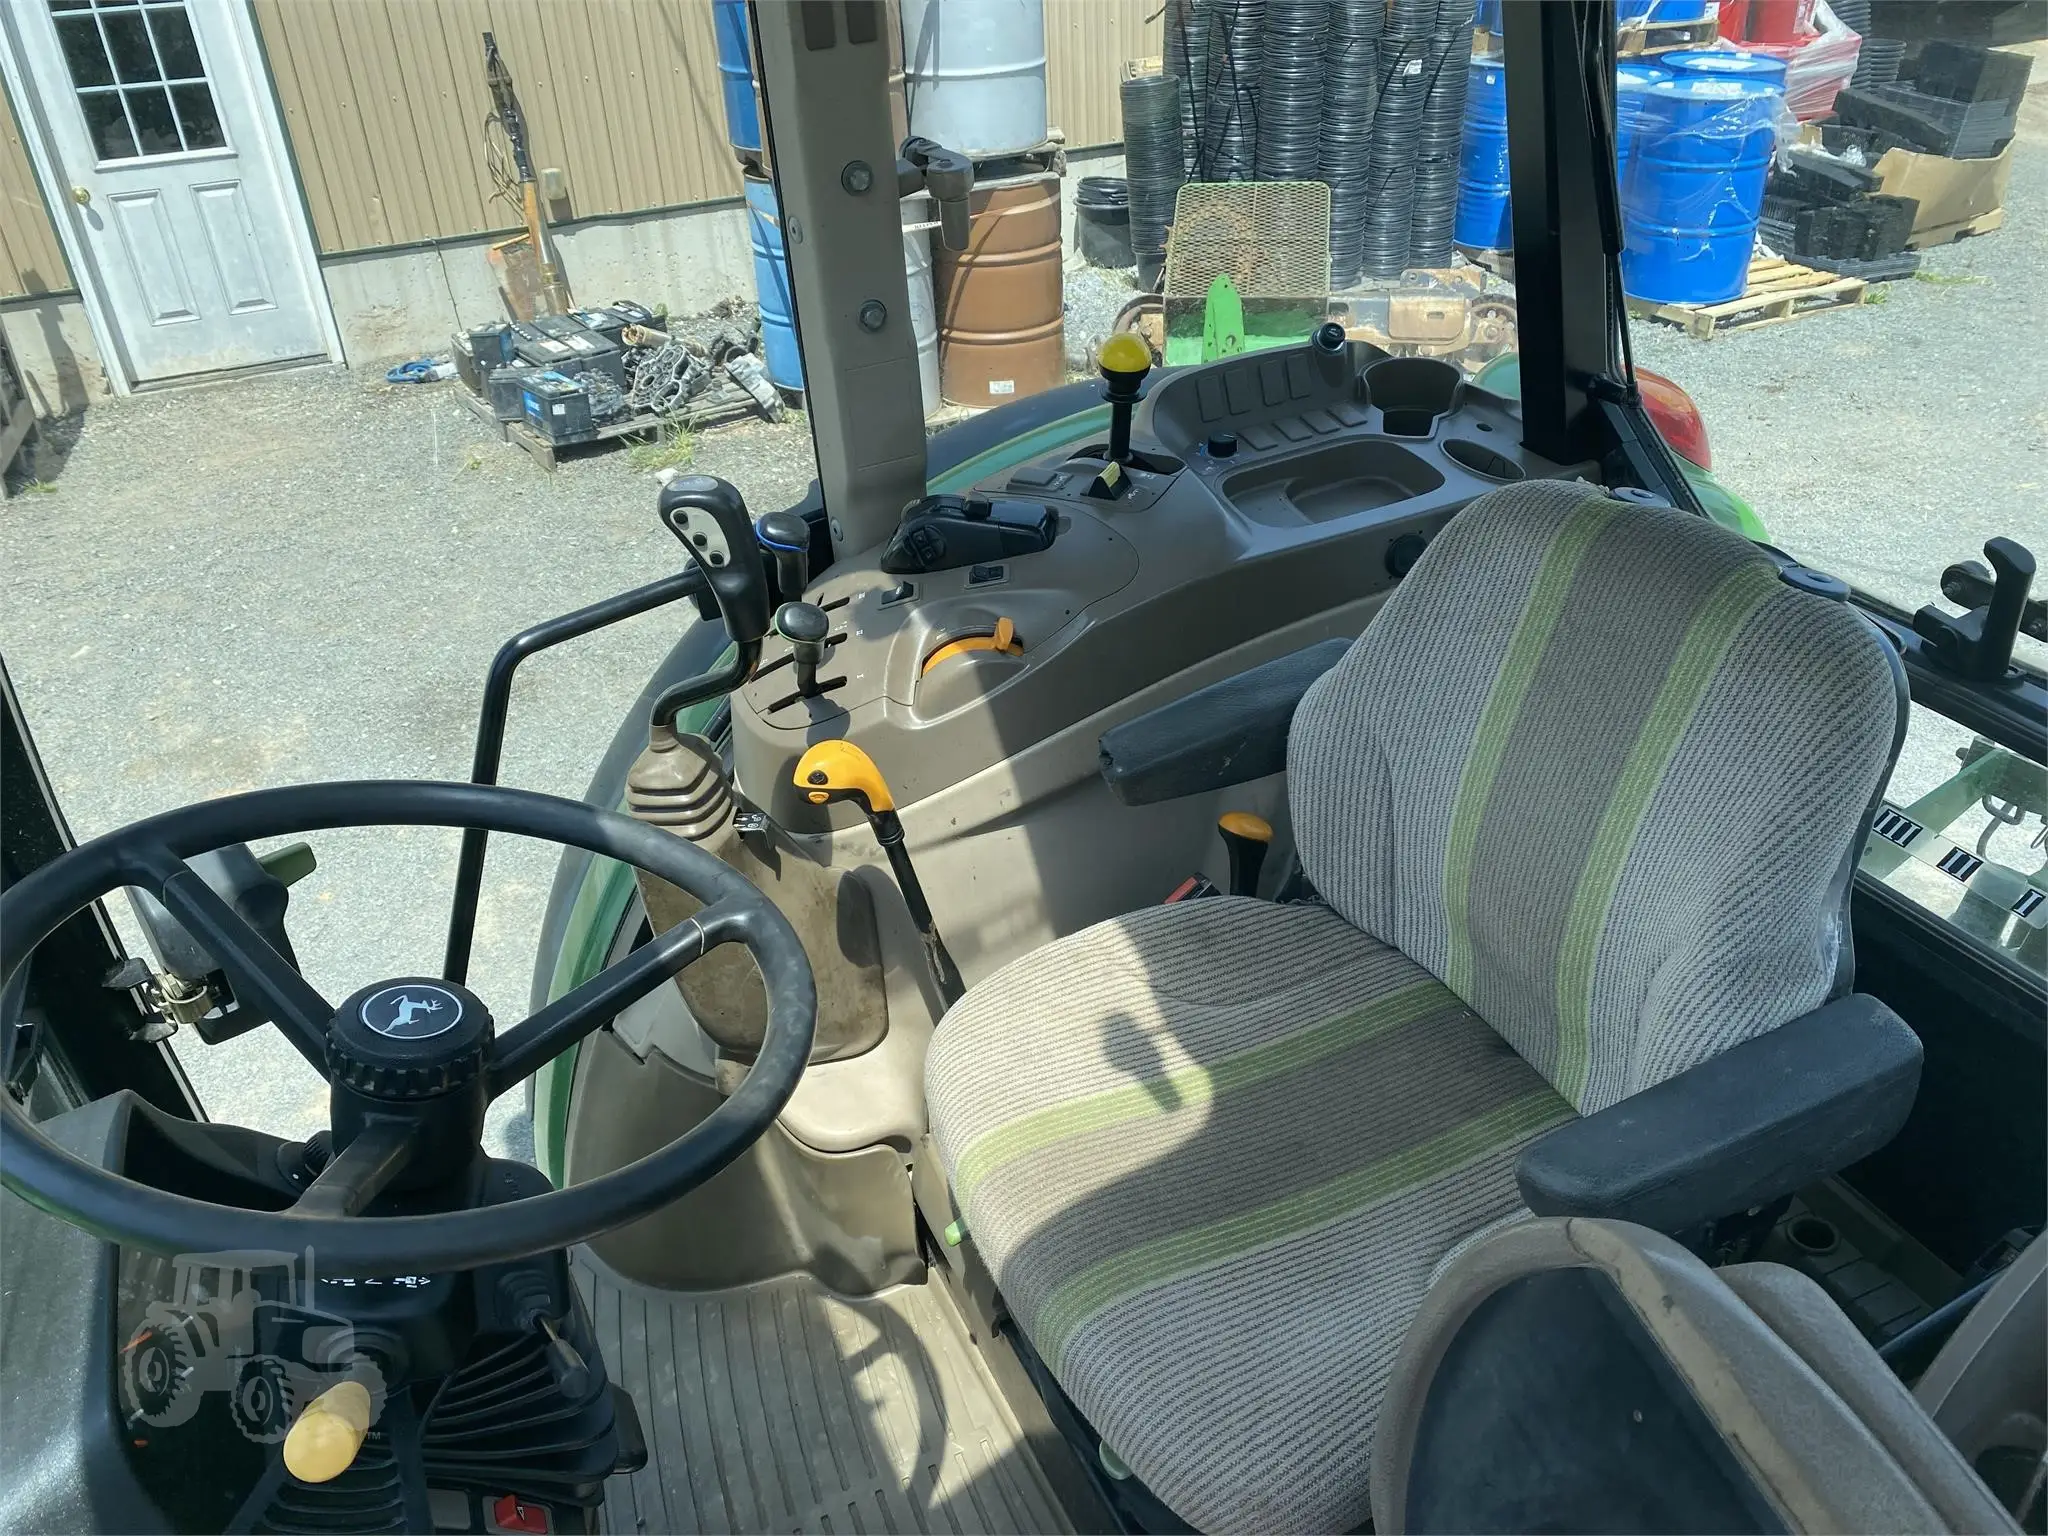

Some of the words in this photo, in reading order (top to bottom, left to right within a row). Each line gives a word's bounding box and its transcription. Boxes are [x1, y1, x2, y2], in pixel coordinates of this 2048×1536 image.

[1874, 810, 1921, 847] III
[1939, 848, 1979, 880] II
[2013, 890, 2043, 917] I
